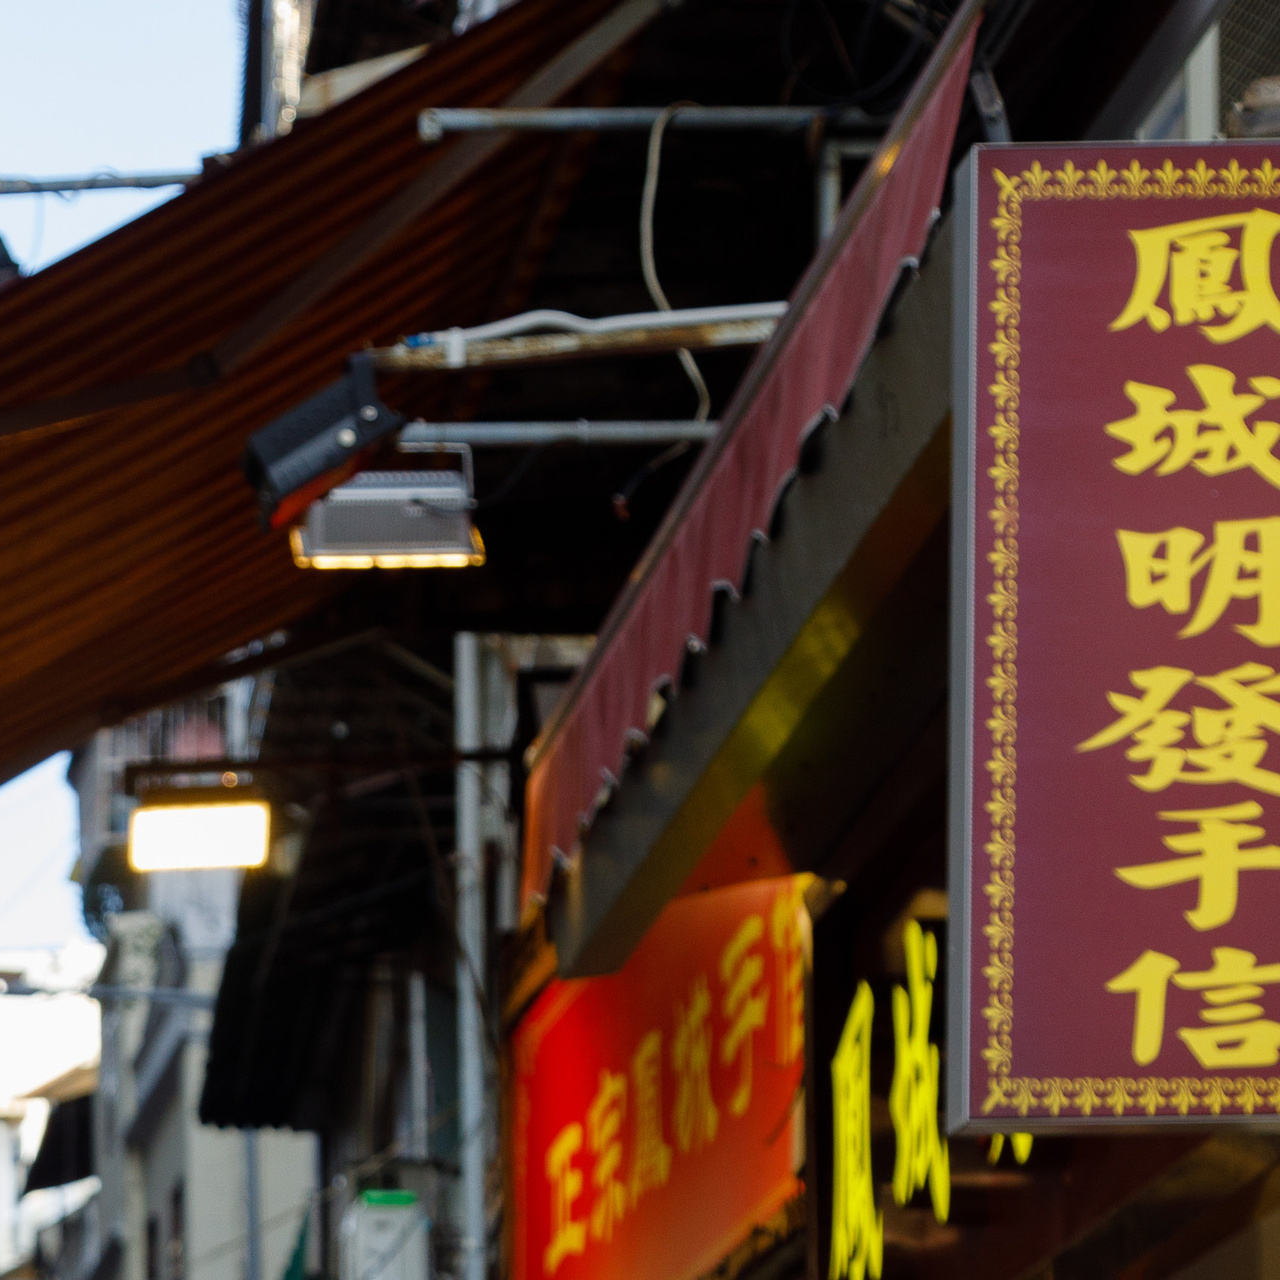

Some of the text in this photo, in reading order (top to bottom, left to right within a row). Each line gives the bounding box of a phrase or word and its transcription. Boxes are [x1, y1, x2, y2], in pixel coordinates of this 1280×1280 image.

[1076, 208, 1280, 1070] 鳳城明發手信
